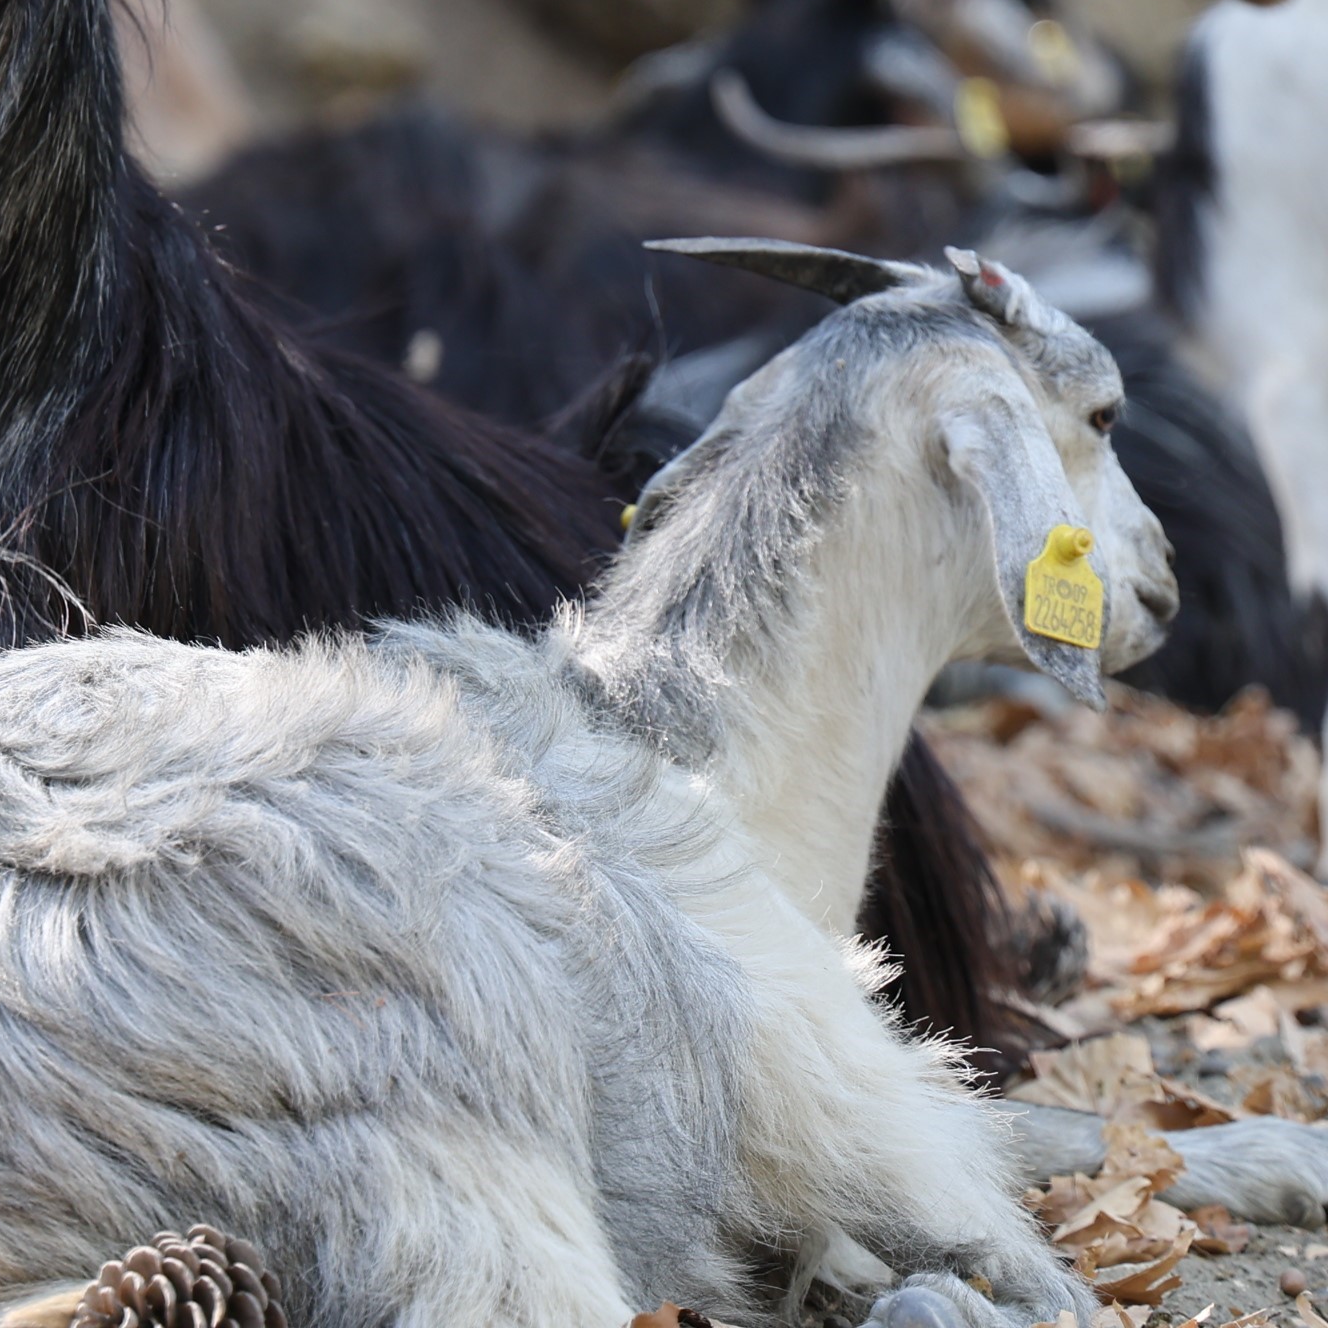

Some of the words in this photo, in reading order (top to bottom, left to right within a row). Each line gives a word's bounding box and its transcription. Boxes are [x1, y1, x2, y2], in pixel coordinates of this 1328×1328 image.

[1042, 574, 1057, 596] TR
[1073, 583, 1088, 604] 09
[1034, 593, 1096, 643] 2264258
